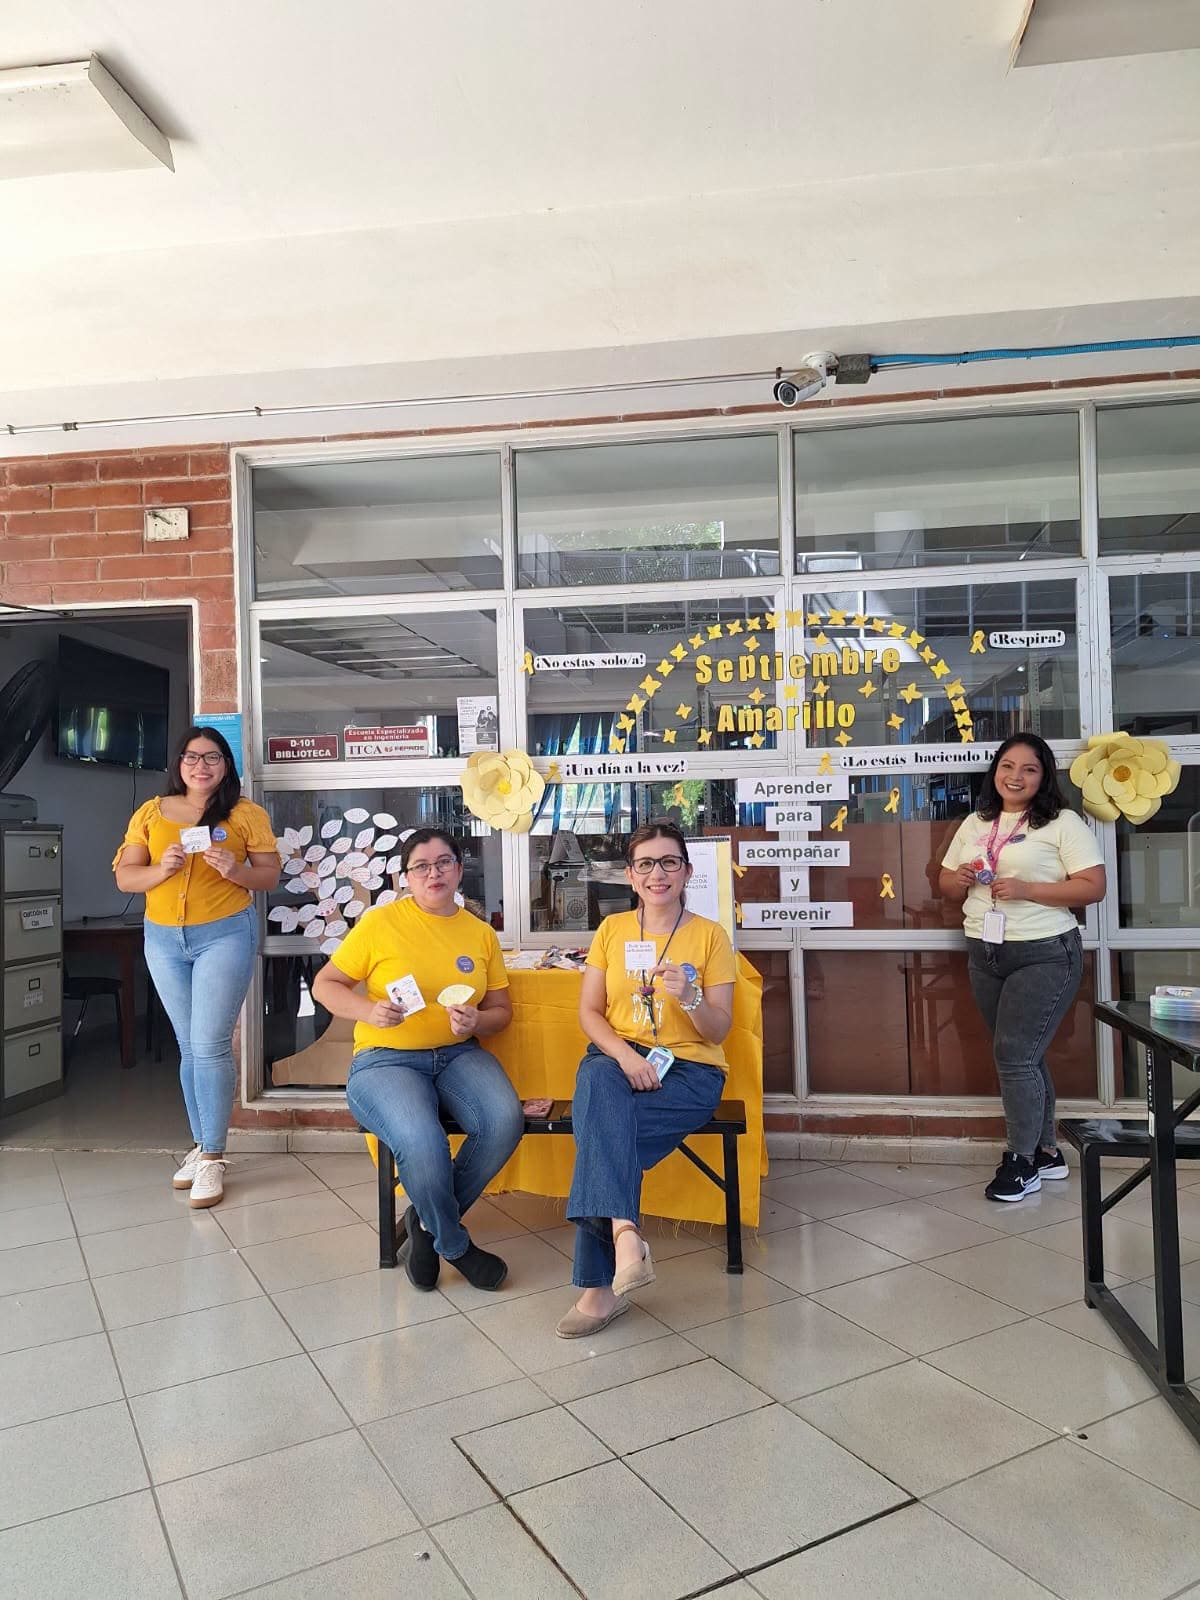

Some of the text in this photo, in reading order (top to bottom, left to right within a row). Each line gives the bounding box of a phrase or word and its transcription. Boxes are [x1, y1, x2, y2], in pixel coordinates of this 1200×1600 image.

[993, 631, 1063, 648] ¡Respira!
[536, 654, 644, 669] ¡No estas solo/a!
[694, 647, 902, 684] Septiembre
[717, 699, 856, 734] Amarillo
[376, 728, 424, 736] Especializada
[290, 738, 316, 748] D-101
[349, 745, 382, 755] ITCA
[275, 749, 332, 759] BIBLIOTECA
[843, 756, 867, 768] ¡Lo
[871, 753, 907, 766] estás
[914, 750, 980, 763] haciendo
[566, 760, 685, 777] ¡Un día a la vez!
[754, 781, 833, 798] Aprender
[775, 810, 813, 825] para
[746, 845, 841, 861] acompañar
[790, 878, 800, 892] y
[761, 907, 832, 922] prevenir
